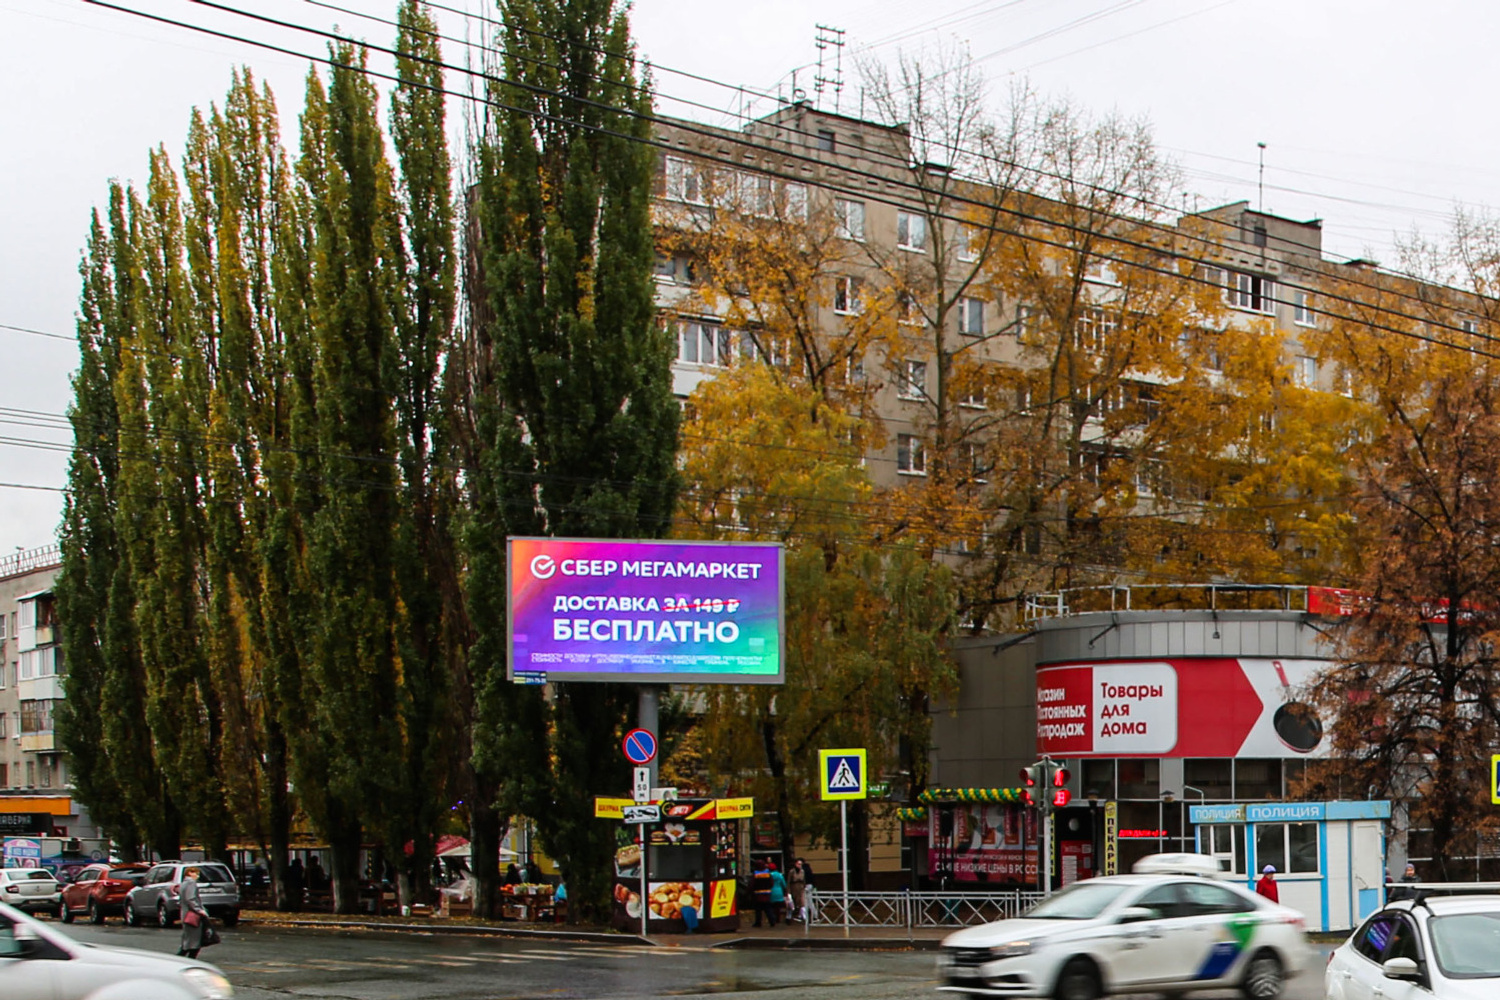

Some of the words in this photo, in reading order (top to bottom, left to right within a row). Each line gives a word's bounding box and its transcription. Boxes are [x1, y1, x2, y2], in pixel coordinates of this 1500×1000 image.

[560, 559, 617, 577] СБЕР
[622, 561, 762, 580] МЕГАМАРКЕТ
[553, 595, 660, 613] ДОСТАВКА
[664, 598, 689, 613] ЗА
[693, 598, 724, 613] 149
[553, 618, 740, 643] БЕСПЛАТНО
[1101, 682, 1163, 701] Товары
[1101, 704, 1130, 719] для
[1101, 721, 1147, 738] дома
[1195, 808, 1241, 820] ПОЛИЦИЯ
[1252, 806, 1320, 819] ПОЛИЦИЯ
[1106, 818, 1115, 876] ПЕКАРНЯ
